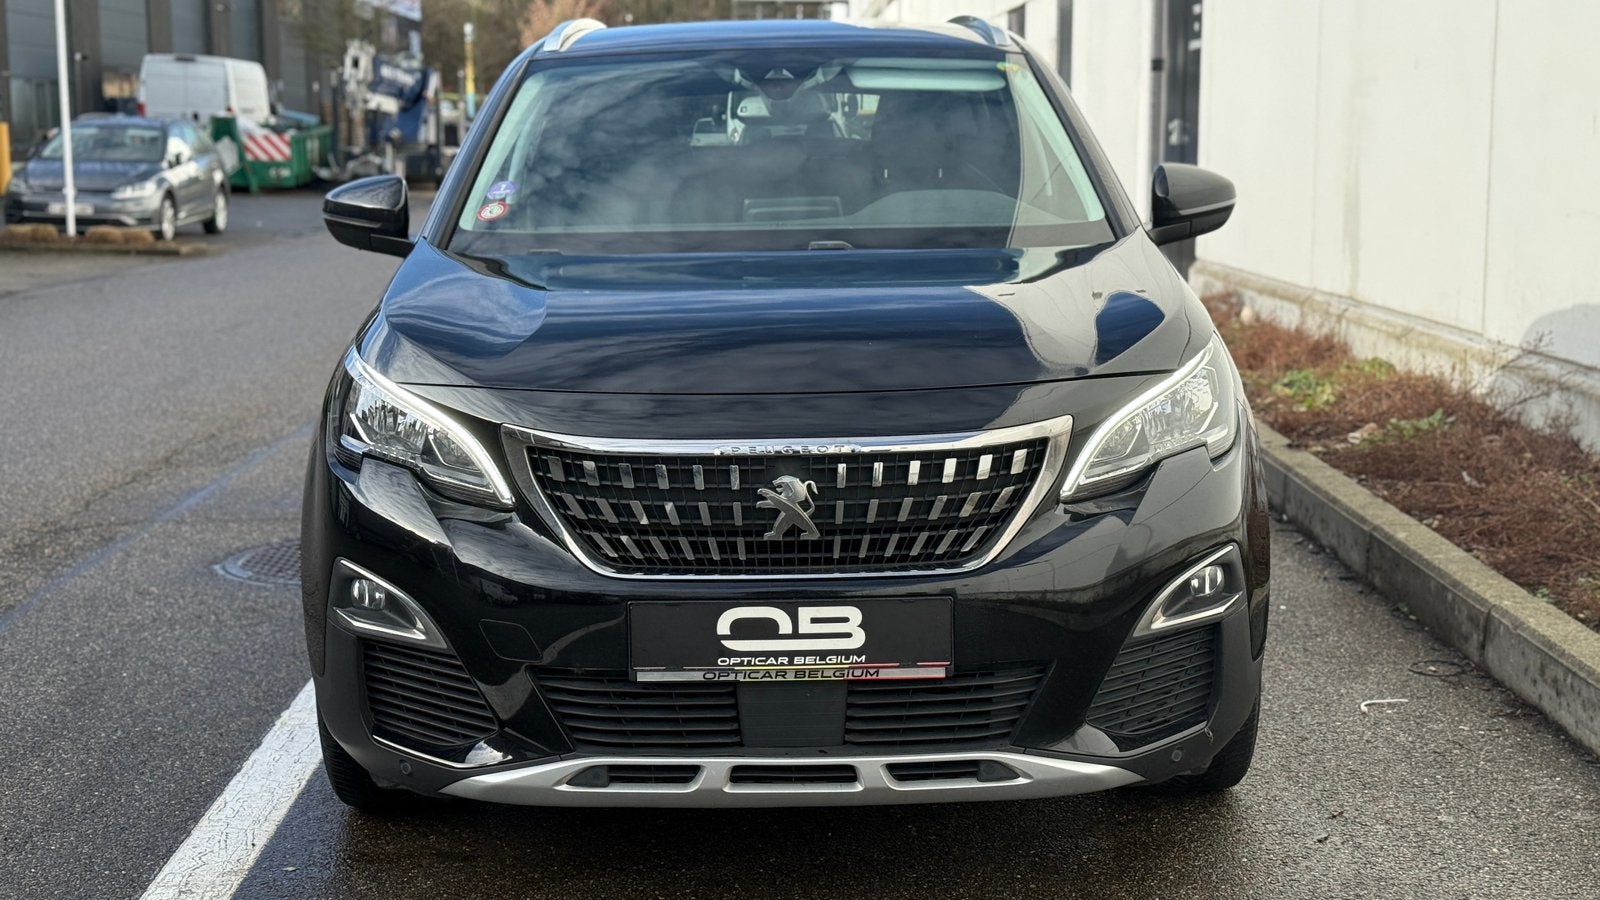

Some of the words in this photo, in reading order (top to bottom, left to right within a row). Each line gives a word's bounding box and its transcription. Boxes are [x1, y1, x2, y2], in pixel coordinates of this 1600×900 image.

[730, 444, 846, 455] PEUGEOT
[717, 656, 789, 666] OPTICAR
[793, 654, 866, 665] BELGIUM
[702, 670, 787, 681] OPTICAR
[793, 668, 880, 680] BELGIUM
